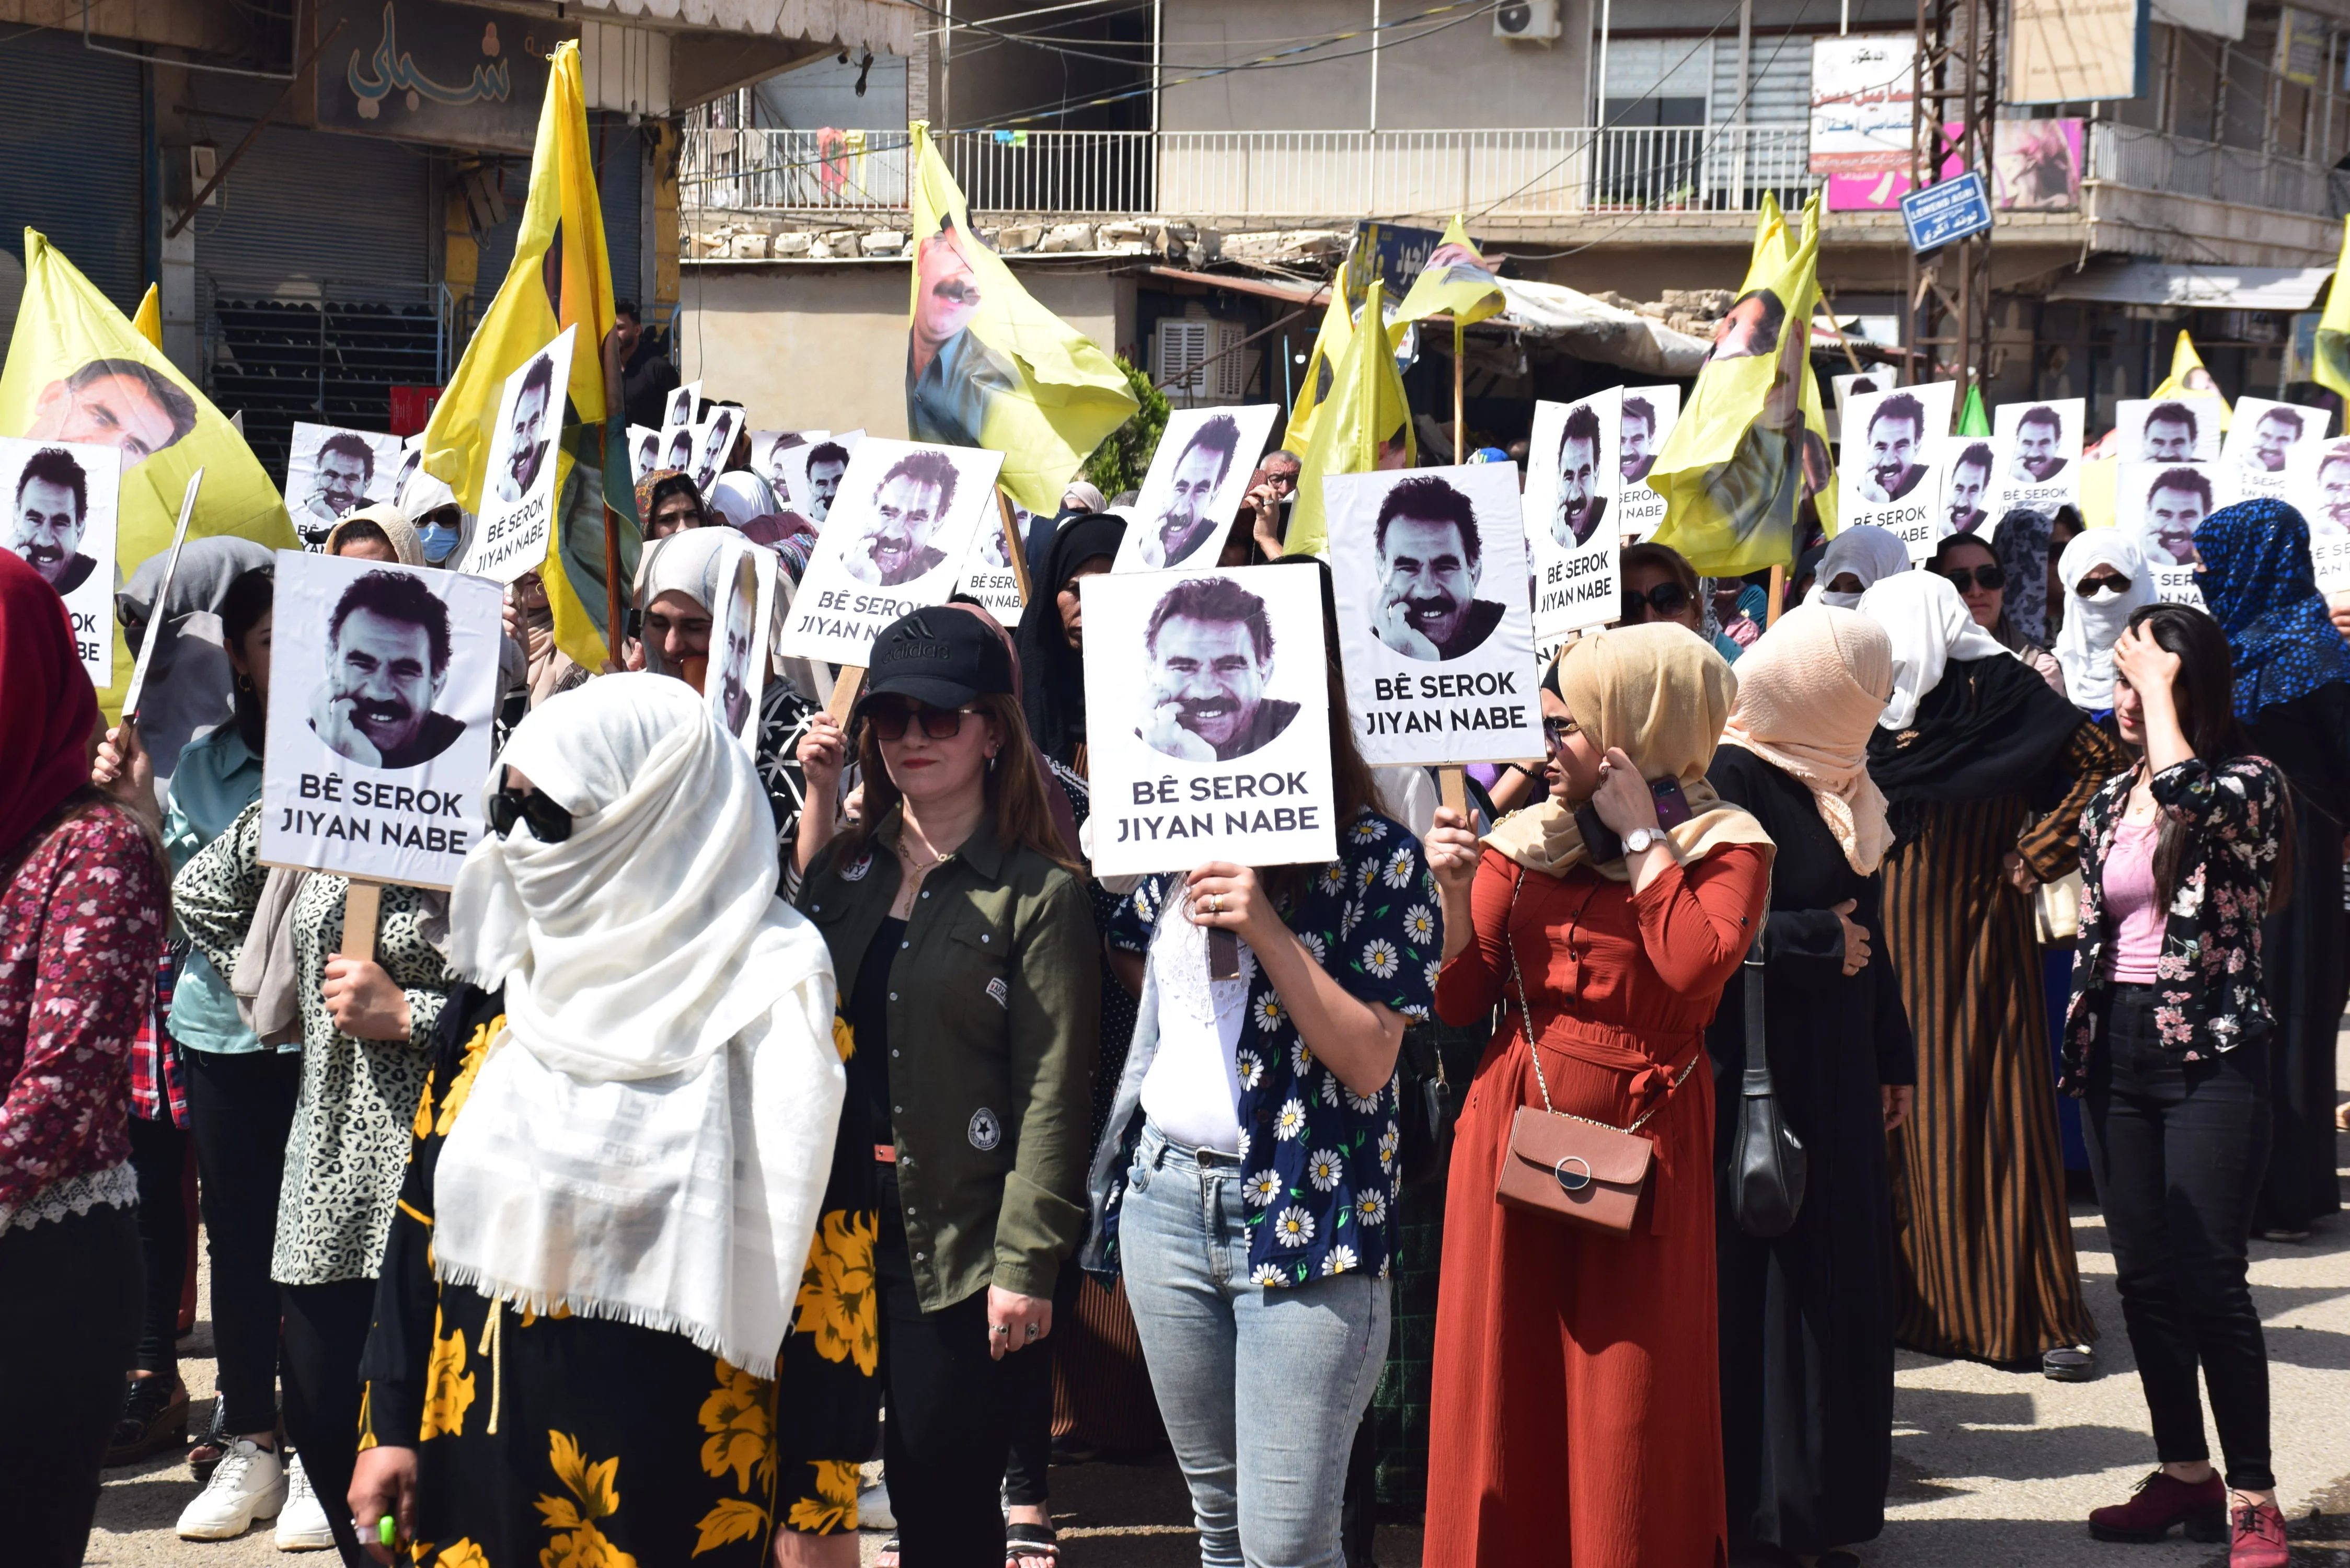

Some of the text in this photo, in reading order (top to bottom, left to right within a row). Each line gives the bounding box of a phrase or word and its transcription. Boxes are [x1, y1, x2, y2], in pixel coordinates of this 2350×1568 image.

[348, 1, 510, 119] شبلي
[2003, 487, 2068, 500] BÊ SEROK
[487, 493, 545, 543] BÊ SEROK
[1626, 505, 1663, 519] NABE
[1877, 505, 1926, 527] SEROK
[476, 518, 545, 574] JIYAN NABE
[971, 573, 987, 587] BÊ
[1548, 550, 1608, 584] BÊ SEROK
[818, 590, 850, 610] BÊ
[1541, 577, 1611, 613] JIYAN NABE
[797, 616, 860, 639] JIYAN
[883, 641, 950, 664] adidas
[1375, 672, 1517, 700] BÊ SEROK
[1367, 706, 1527, 735] JIYAN NABE
[300, 773, 463, 818] BÊ SEROK
[1133, 771, 1309, 805] BÊ SEROK
[281, 808, 467, 855] JIYAN NABE
[1118, 806, 1319, 843] JIYAN NABE
